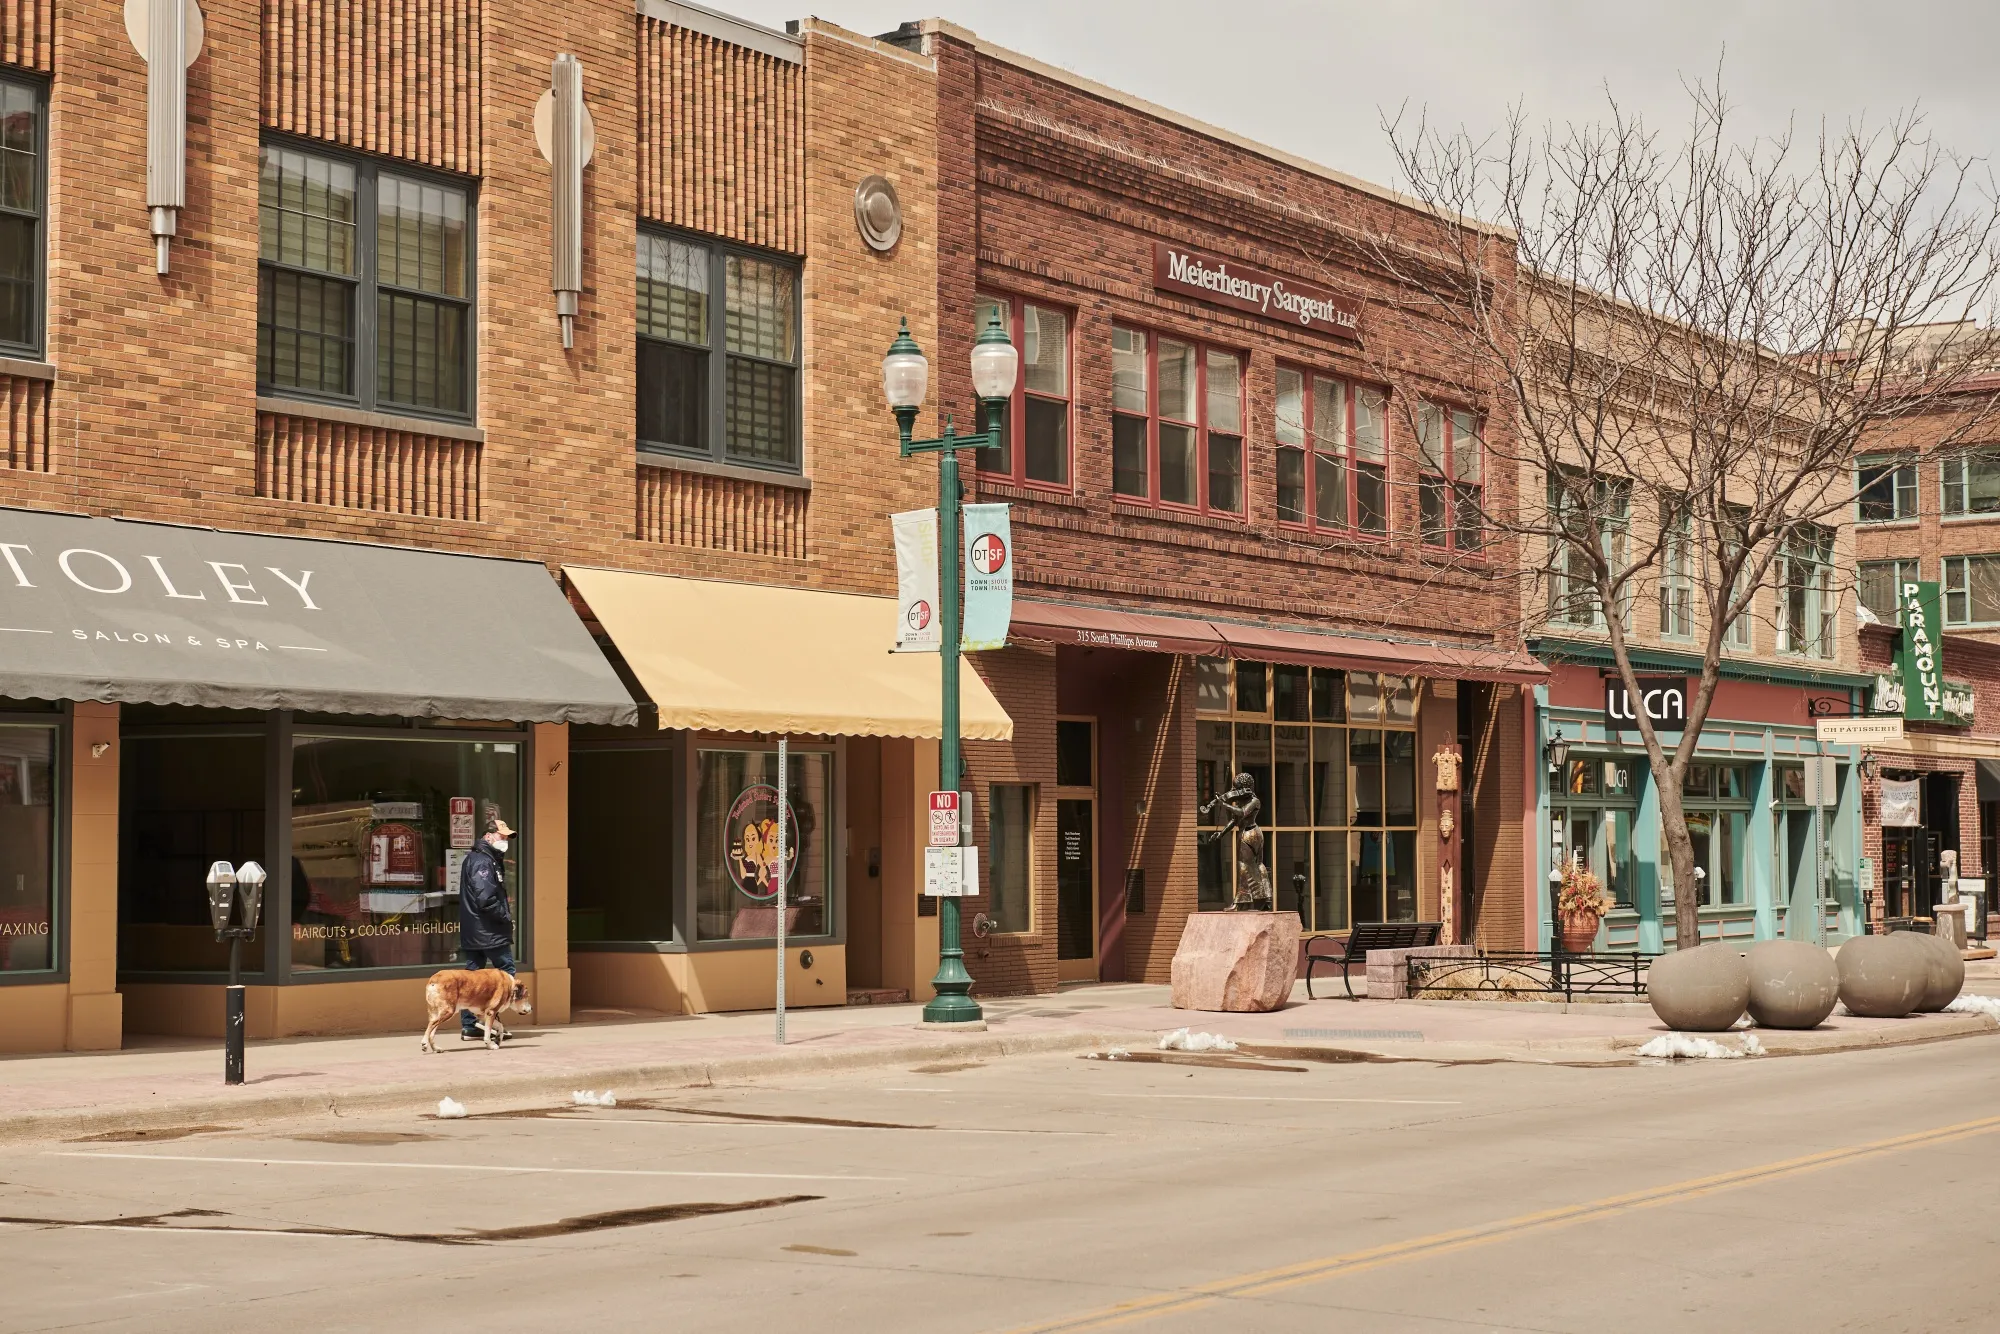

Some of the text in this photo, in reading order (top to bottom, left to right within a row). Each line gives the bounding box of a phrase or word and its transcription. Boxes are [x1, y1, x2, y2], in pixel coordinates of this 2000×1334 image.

[1168, 250, 1357, 329] Meierhenry Sargent LLP
[0, 542, 322, 611] TOLEY
[72, 628, 269, 652] SALON & SPA
[1077, 630, 1158, 648] 315 South Phillips Avenue
[1903, 583, 1941, 716] PARAMOUNT
[1609, 689, 1683, 720] LUCA
[936, 794, 951, 808] NO
[293, 921, 461, 939] HAIRCUTS COLORS HIGHLIGH
